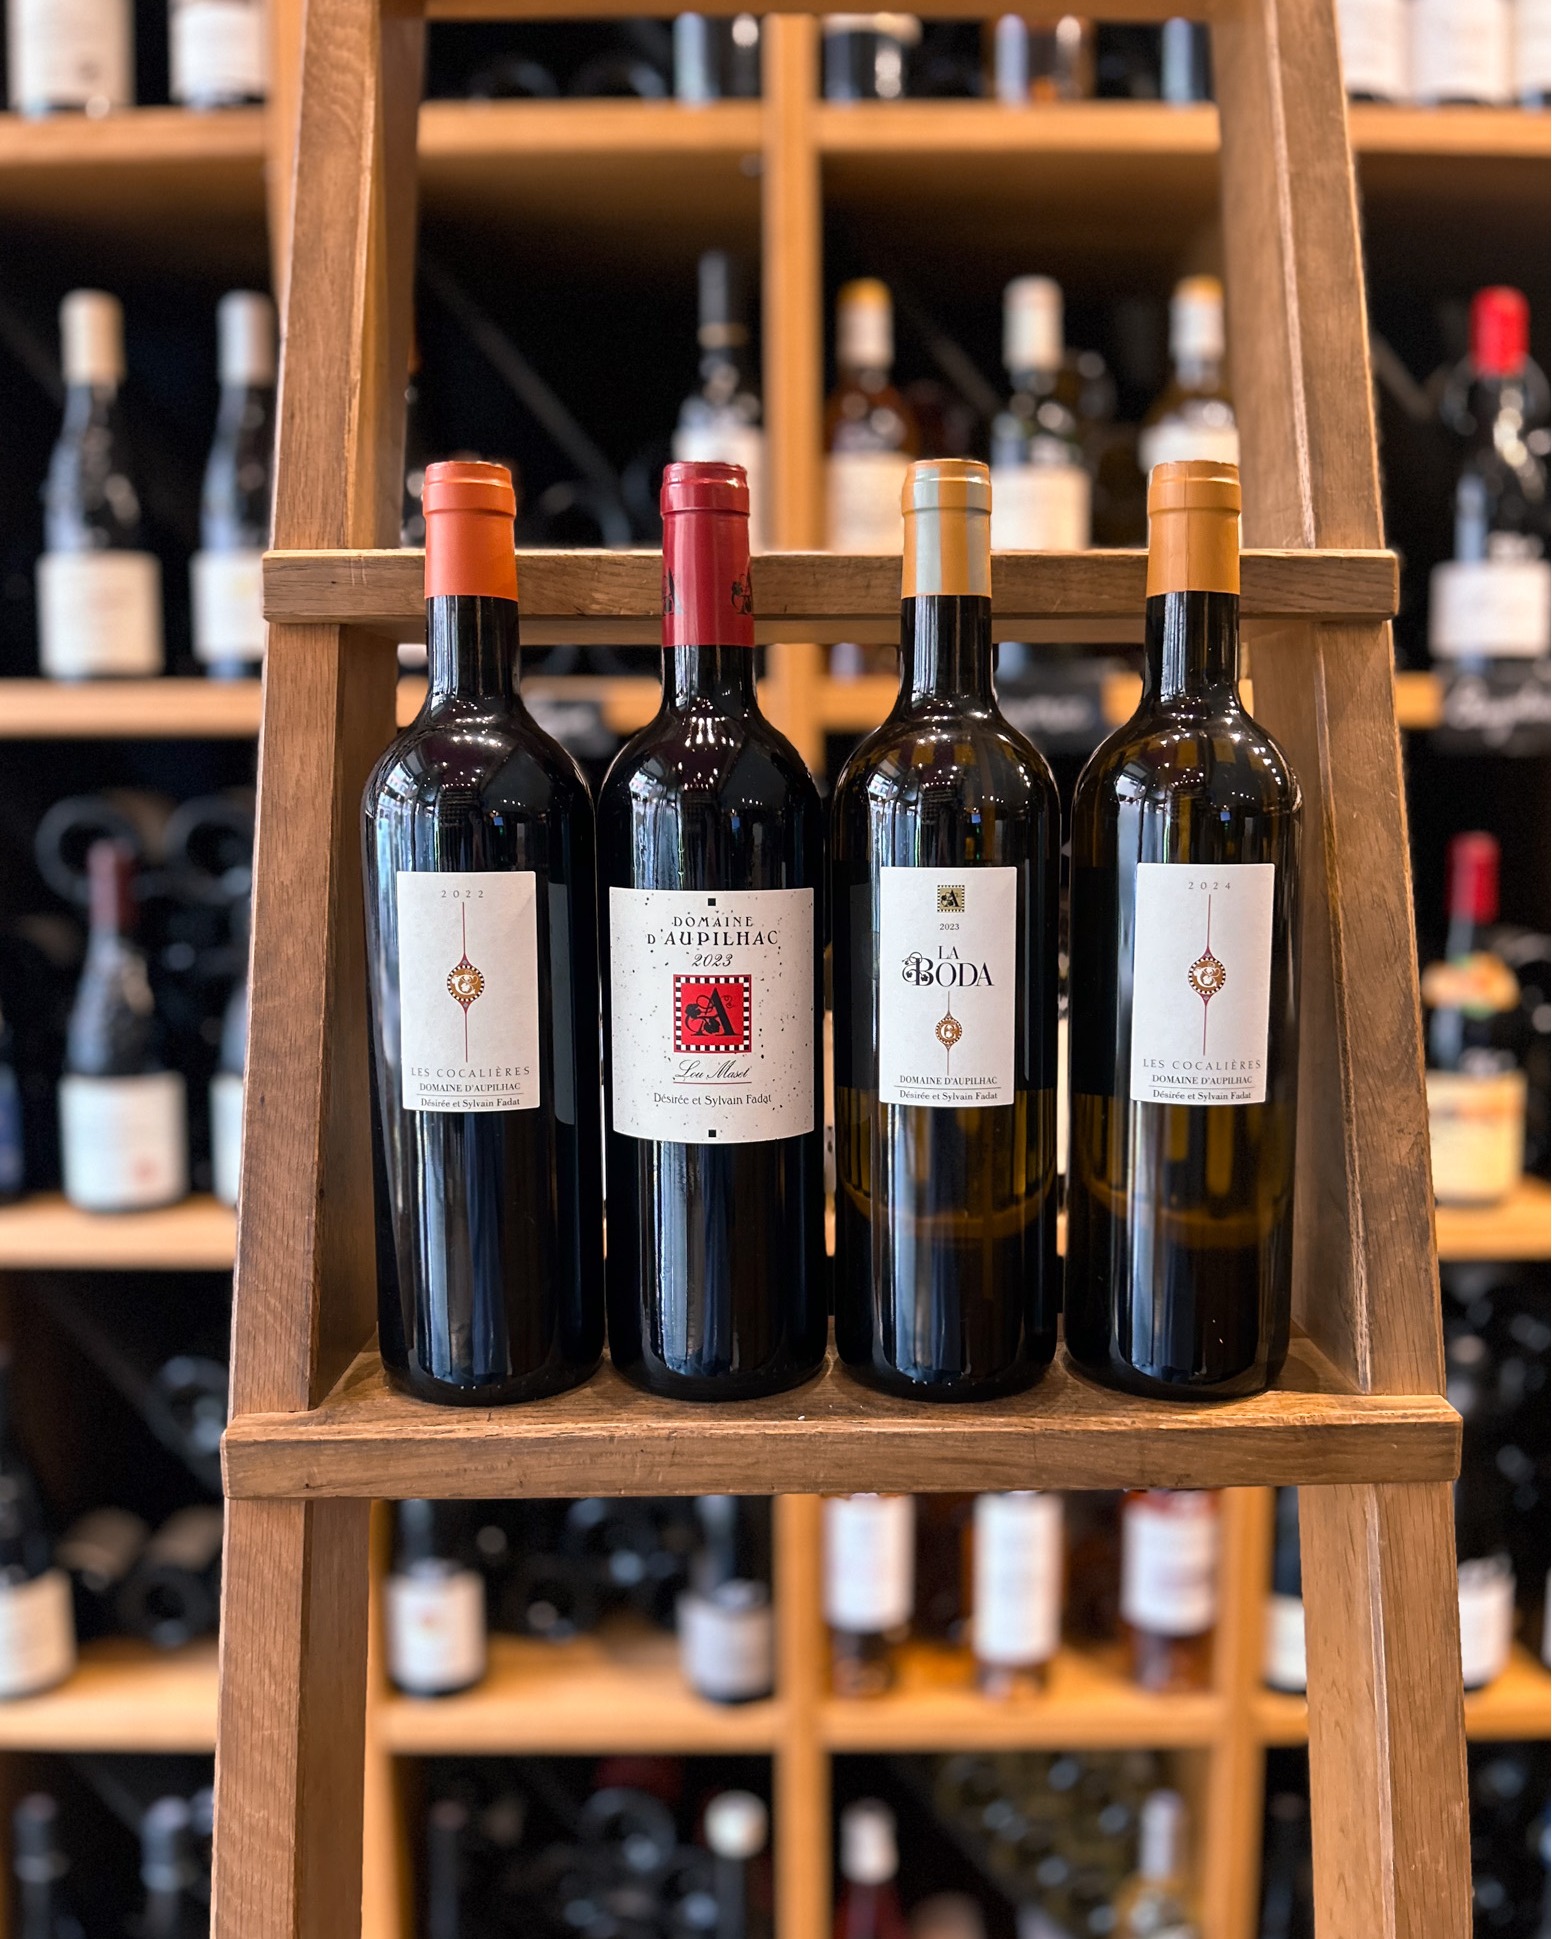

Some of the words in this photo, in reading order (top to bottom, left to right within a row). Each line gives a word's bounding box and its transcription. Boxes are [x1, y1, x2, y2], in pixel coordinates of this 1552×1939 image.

[1188, 881, 1231, 891] 2024
[441, 889, 484, 899] 2022
[673, 916, 754, 928] DOMAINE
[939, 923, 960, 931] 2023
[938, 945, 960, 960] LA
[692, 953, 733, 967] 2023
[902, 951, 995, 988] BODA
[674, 1059, 704, 1082] Lou
[1143, 1058, 1165, 1069] LES
[1172, 1059, 1262, 1071] COCALIÈRES
[411, 1067, 430, 1077] LES
[436, 1065, 530, 1078] COCALIÈRES
[899, 1075, 943, 1085] DOMAINE
[944, 1076, 998, 1086] D'AUPILHAC
[1152, 1074, 1199, 1085] DOMAINE
[1201, 1076, 1253, 1086] D'AUPILHAC
[419, 1082, 463, 1093] DOMAINE
[465, 1082, 521, 1093] D'AUPILHAC
[653, 1092, 690, 1105] Désirée
[692, 1096, 702, 1106] et
[704, 1094, 744, 1108] Sylvain
[746, 1093, 772, 1105] Fadat
[899, 1089, 930, 1100] Désirée
[942, 1091, 973, 1102] Sylvain
[975, 1091, 998, 1100] Fadat
[1153, 1089, 1186, 1100] Désirée
[1187, 1092, 1196, 1100] et
[1197, 1091, 1229, 1102] Sylvain
[1230, 1091, 1252, 1100] Fadat
[421, 1097, 451, 1108] Désirée
[462, 1099, 494, 1110] Sylvain
[496, 1097, 520, 1107] Fadat
